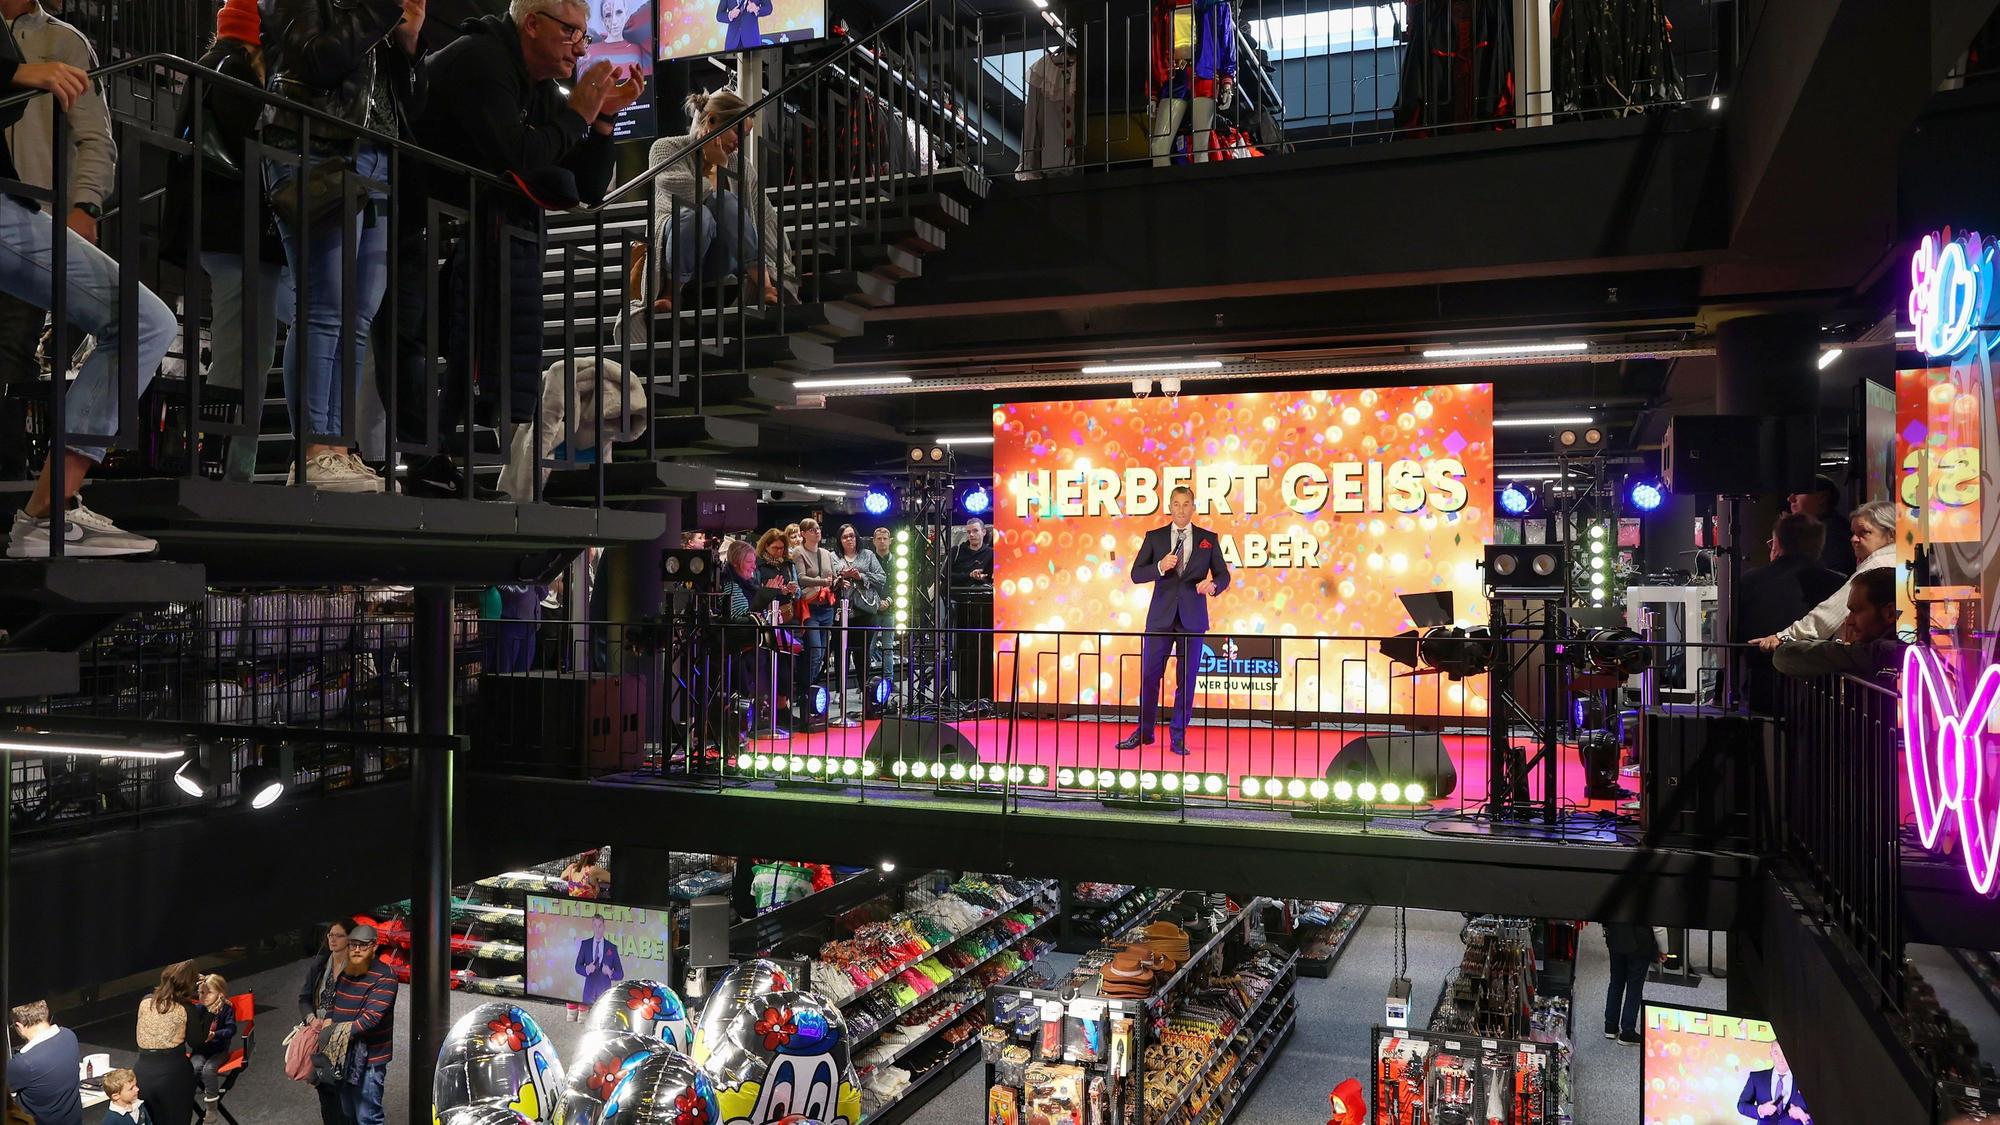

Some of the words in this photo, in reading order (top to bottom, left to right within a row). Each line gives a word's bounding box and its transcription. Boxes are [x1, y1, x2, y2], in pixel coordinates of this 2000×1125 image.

[1015, 464, 1269, 518] HERBERT
[1281, 458, 1468, 514] GEISS
[1219, 534, 1320, 569] ABER
[1198, 681, 1222, 690] WER
[1223, 681, 1239, 690] DU
[1241, 681, 1279, 691] WILLST
